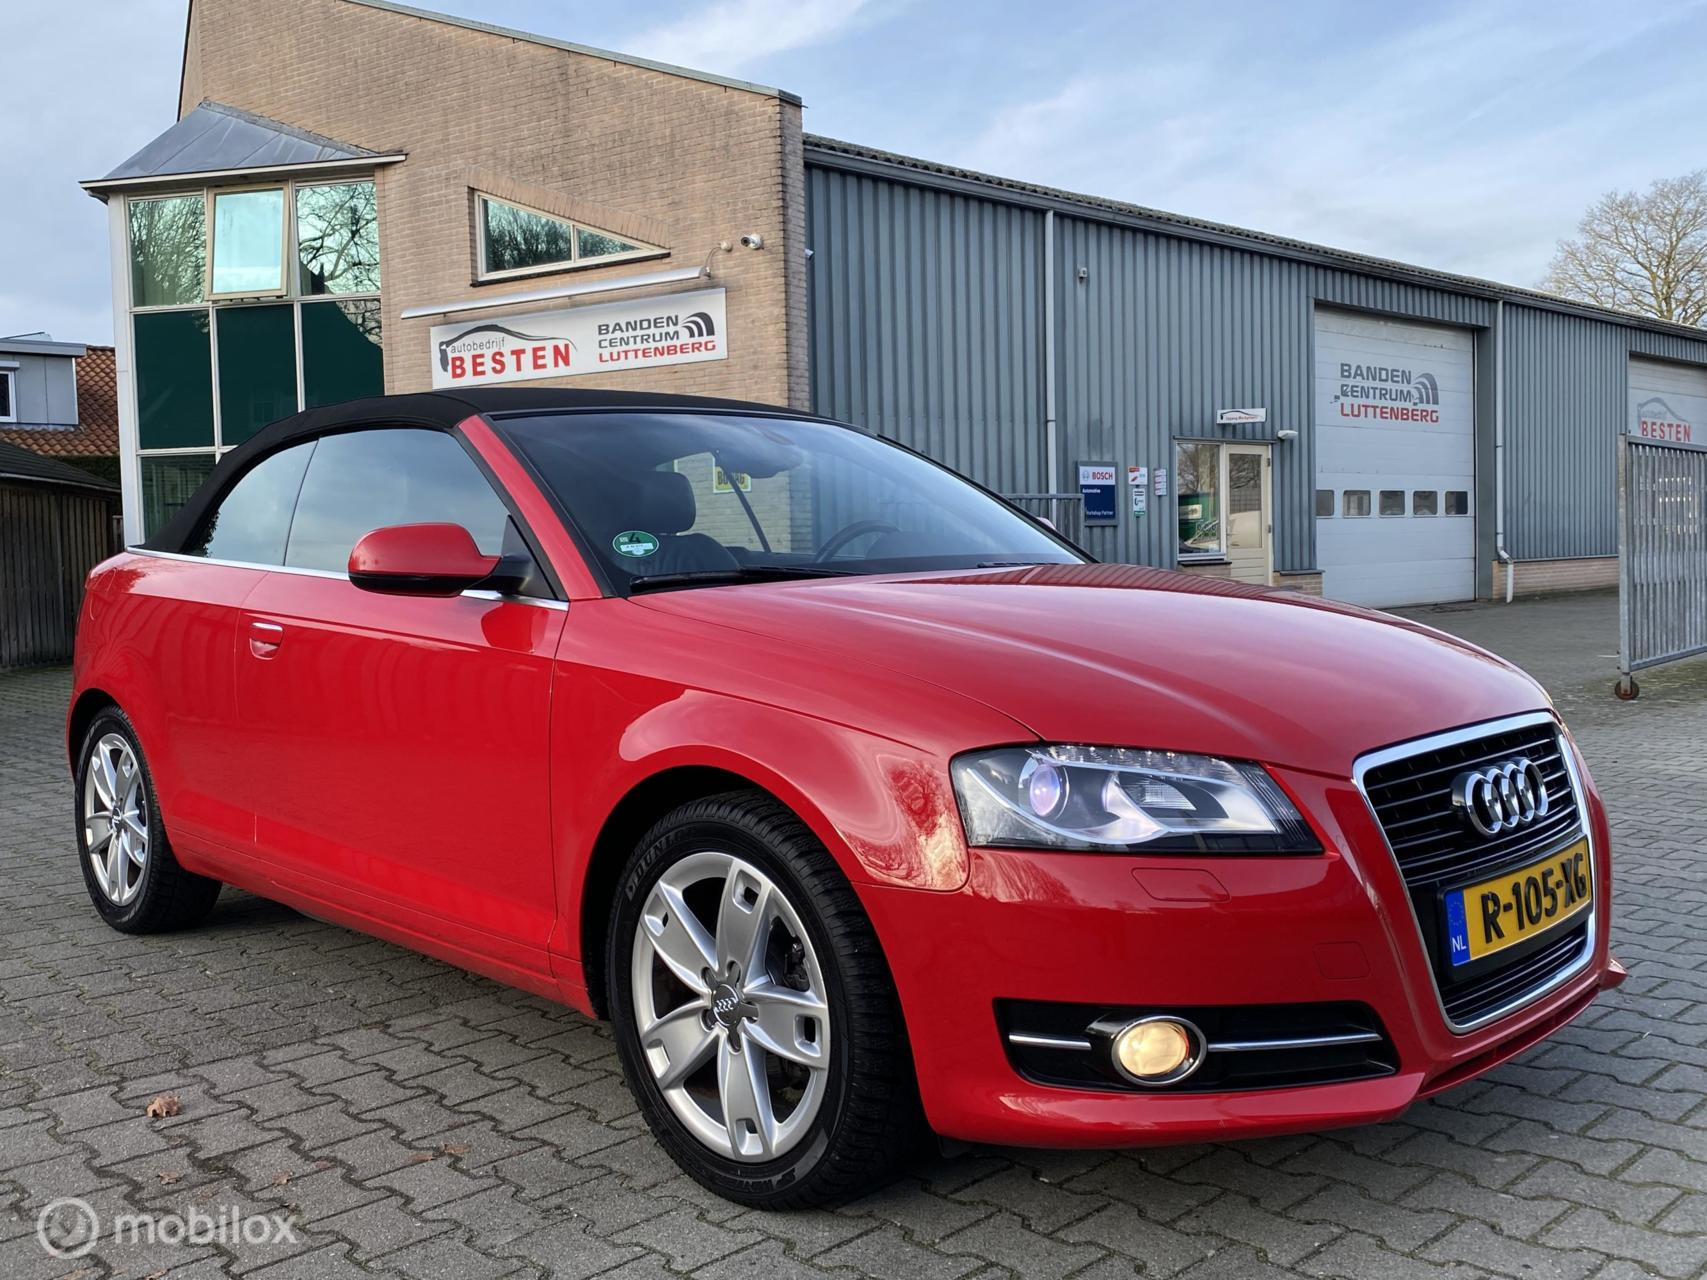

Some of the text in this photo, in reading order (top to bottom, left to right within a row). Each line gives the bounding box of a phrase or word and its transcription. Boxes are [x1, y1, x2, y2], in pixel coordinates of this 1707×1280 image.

[598, 315, 679, 335] BANDEN
[451, 336, 505, 354] autobedrijf
[599, 331, 680, 349] CENTRUM
[450, 343, 571, 379] BESTEN
[599, 340, 717, 363] LUTTENBERG
[1340, 363, 1411, 385] BANDEN
[1340, 383, 1412, 403] CENTRUM
[1340, 402, 1439, 423] LUTTENBERG
[1641, 420, 1691, 443] BESTEN
[1092, 471, 1113, 481] BOSCH
[1480, 852, 1588, 944] R-105-XG
[1451, 935, 1467, 953] NL
